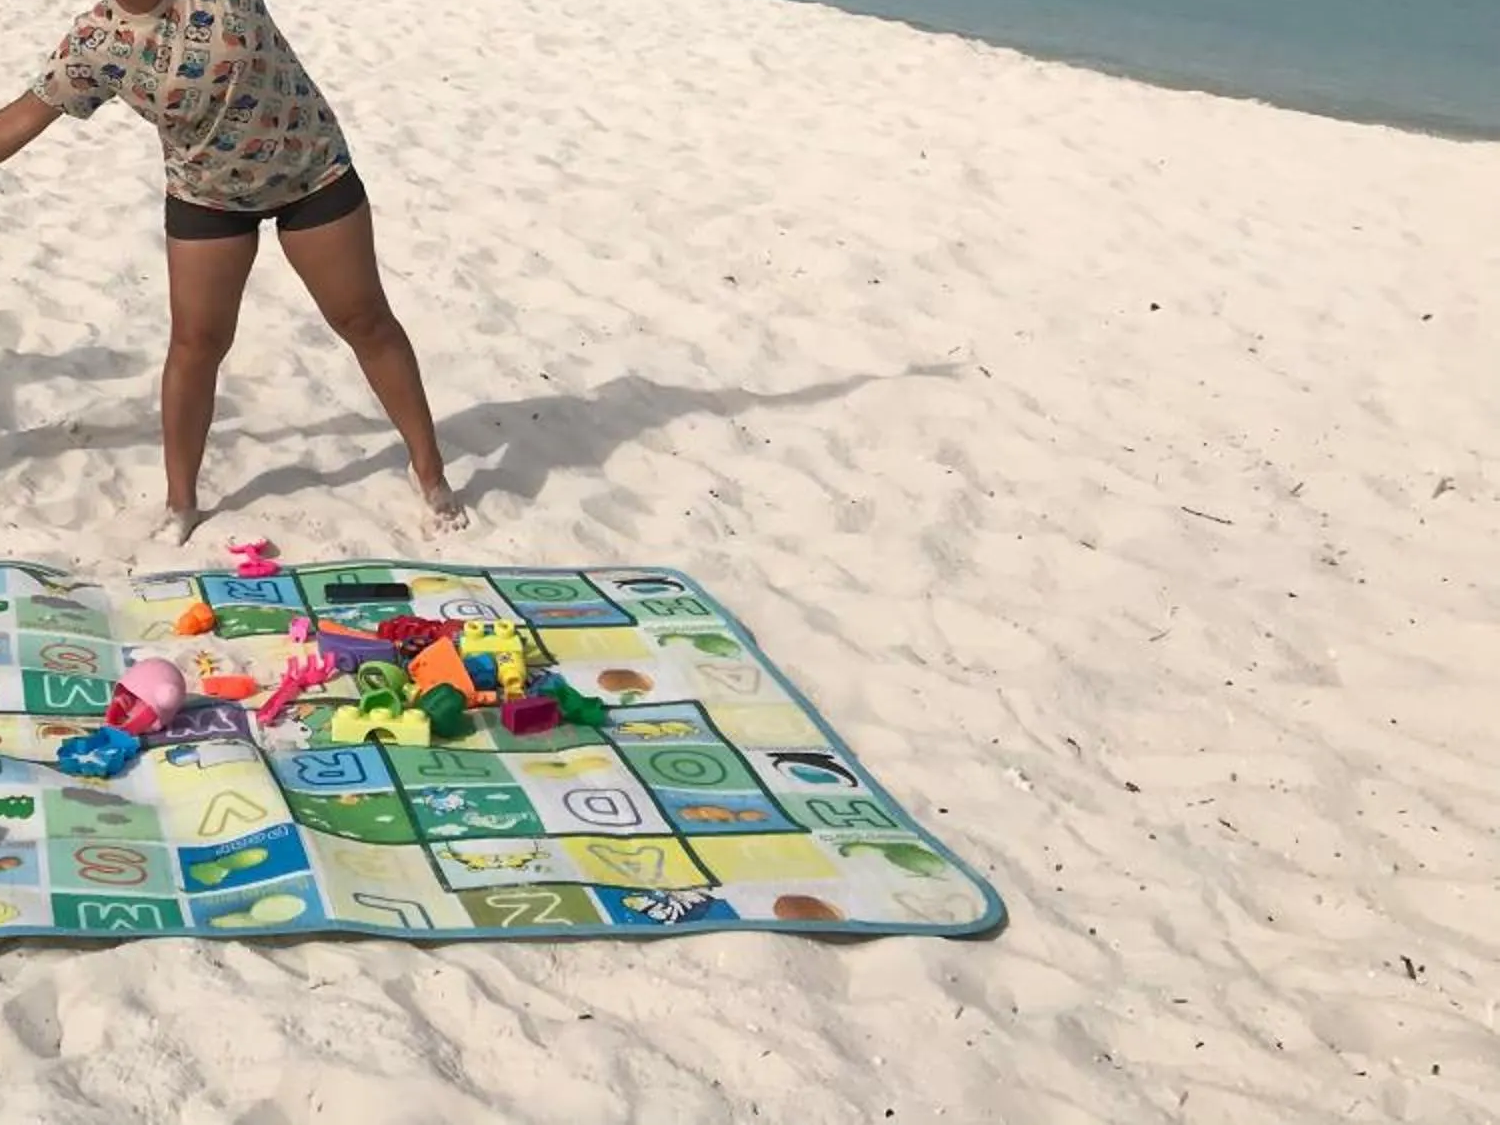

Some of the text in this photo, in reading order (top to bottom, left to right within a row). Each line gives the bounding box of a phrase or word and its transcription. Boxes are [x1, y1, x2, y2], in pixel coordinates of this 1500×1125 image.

[228, 581, 285, 603] R
[293, 750, 367, 786] R
[418, 748, 492, 778] T
[649, 748, 727, 785] O
[561, 787, 641, 827] D
[75, 844, 149, 886] S
[587, 843, 666, 883] A
